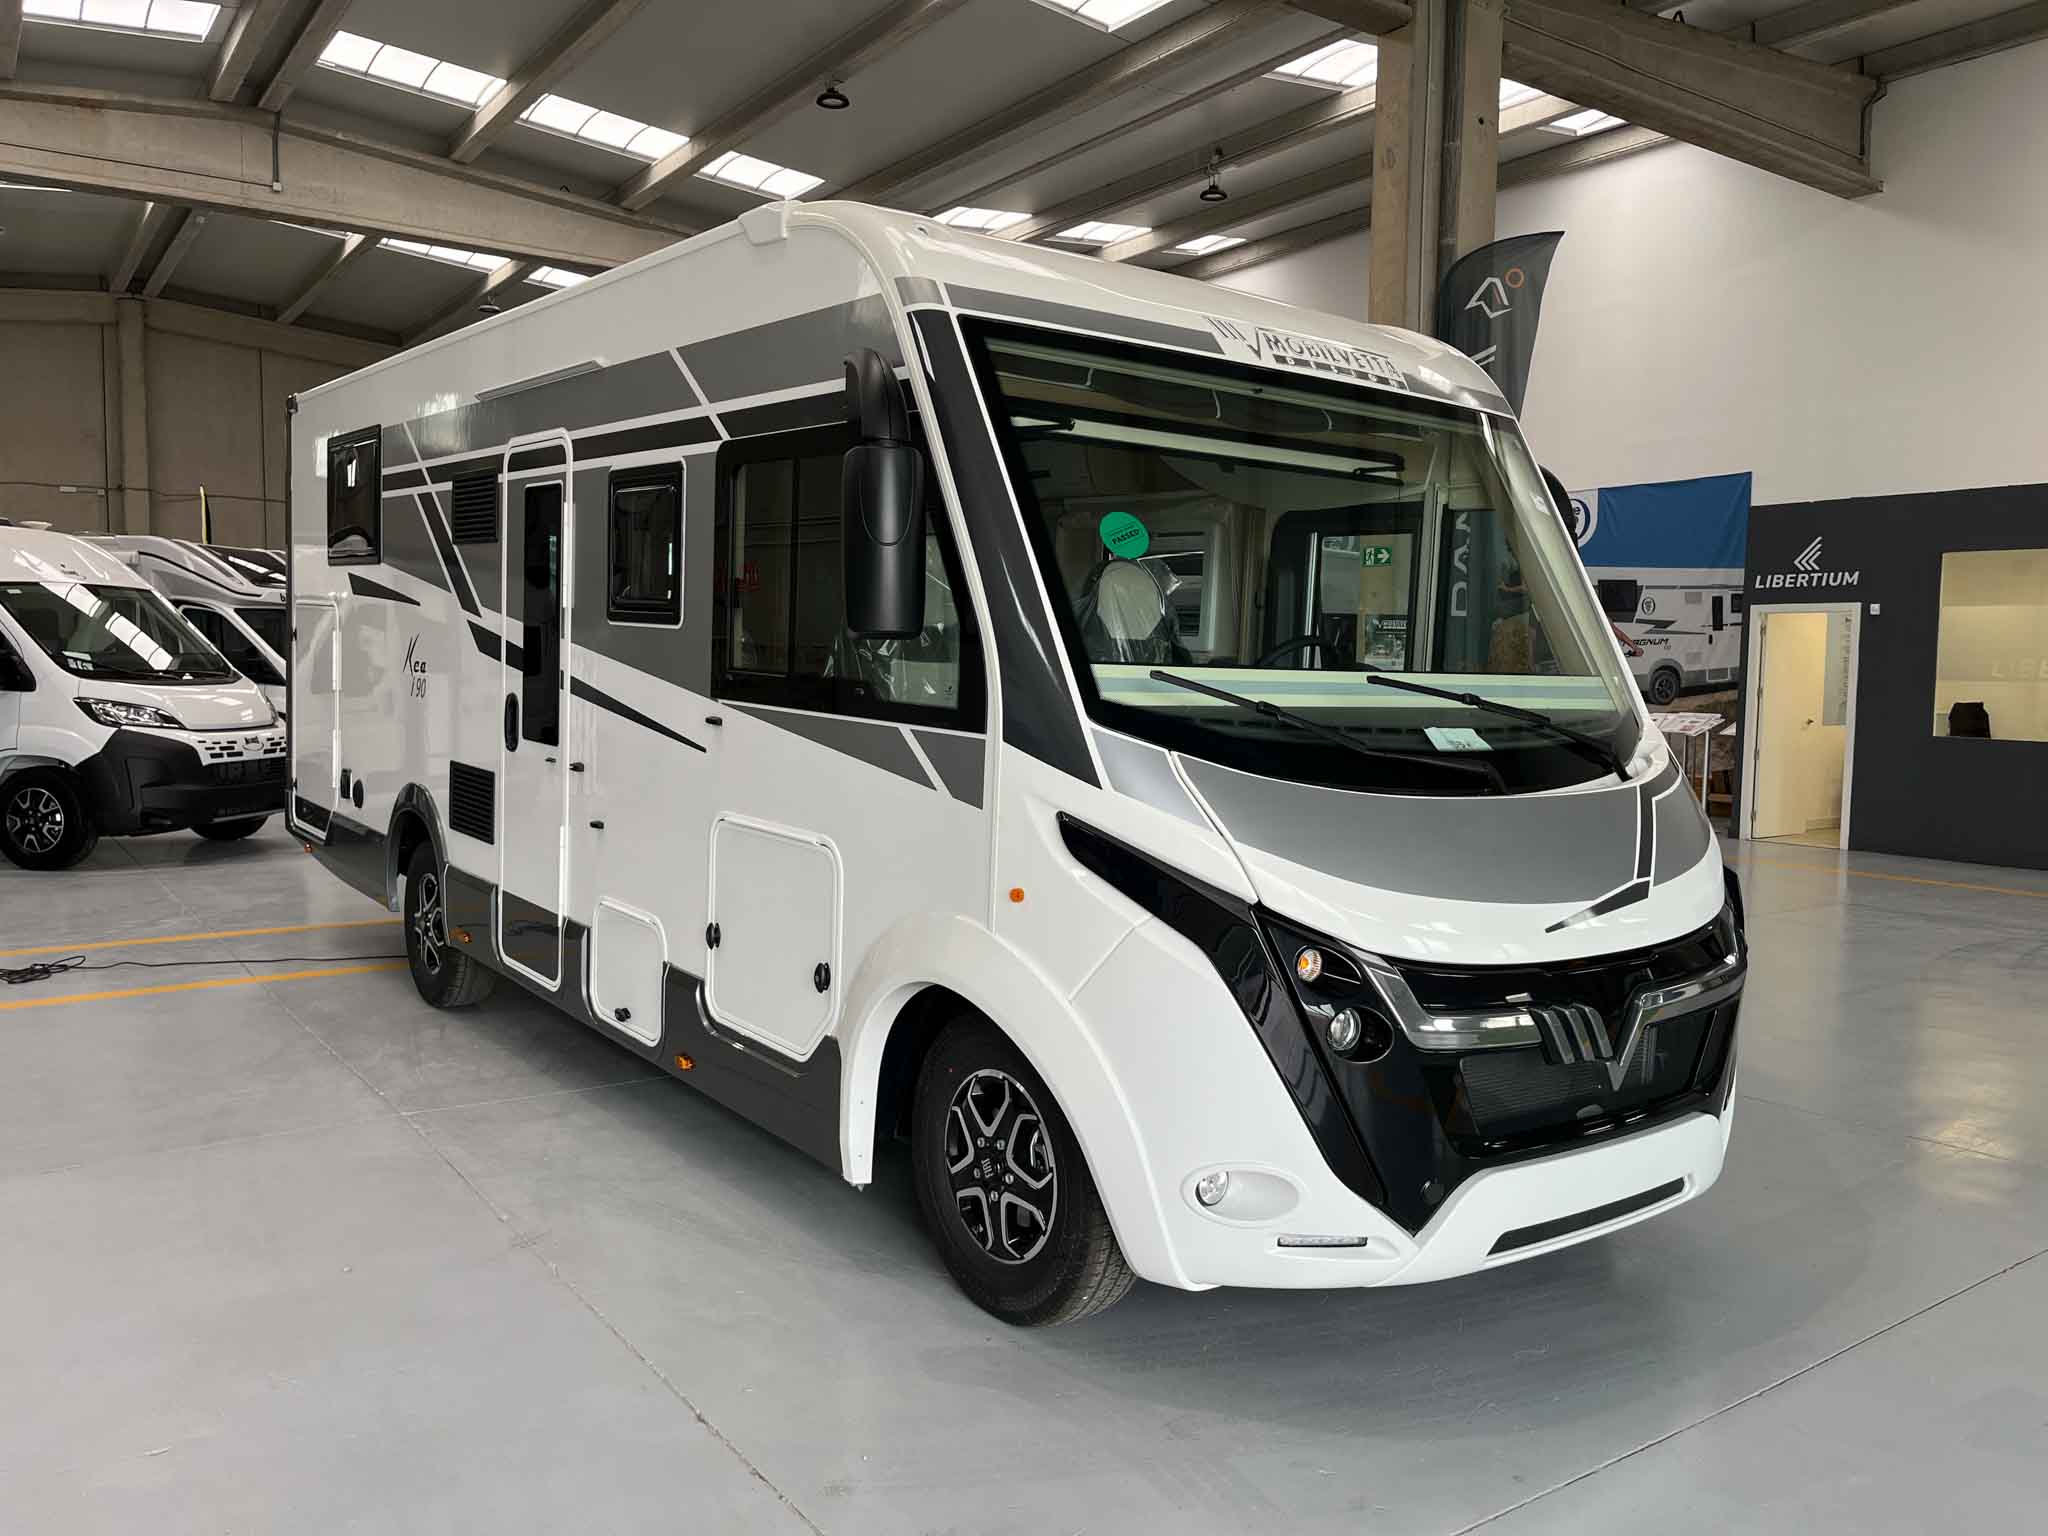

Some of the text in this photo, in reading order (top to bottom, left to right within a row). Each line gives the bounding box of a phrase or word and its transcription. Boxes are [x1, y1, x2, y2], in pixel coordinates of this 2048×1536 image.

[1262, 331, 1403, 378] MOBILVETTA
[1754, 570, 1860, 589] LIBERTIUM
[1624, 638, 1669, 647] AGNUM
